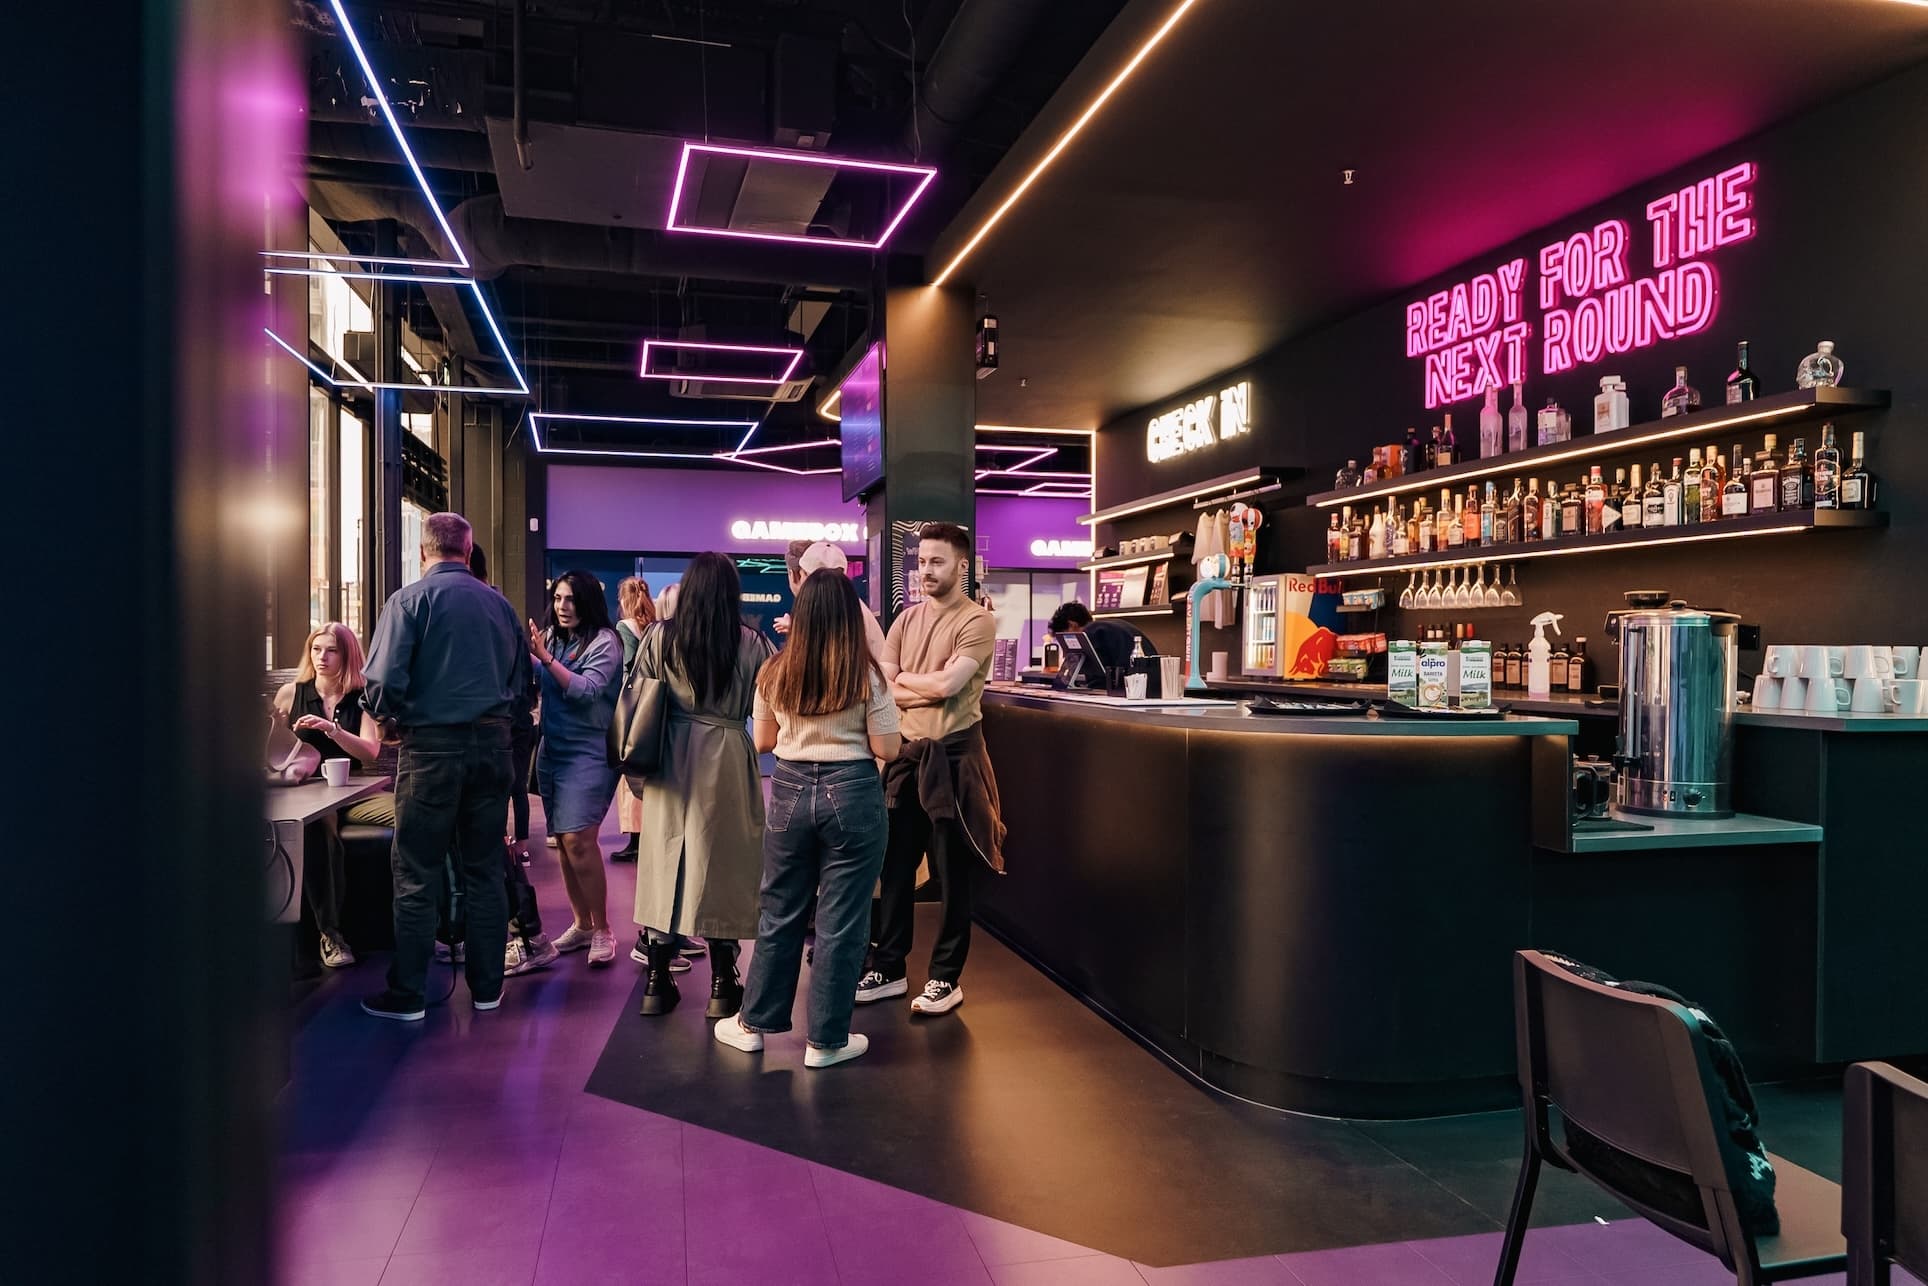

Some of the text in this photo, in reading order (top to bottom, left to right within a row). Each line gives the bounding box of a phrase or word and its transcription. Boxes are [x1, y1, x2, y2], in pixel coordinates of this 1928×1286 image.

[1406, 162, 1757, 357] READY FOR THE
[1424, 261, 1717, 409] NEXT ROUND
[1146, 395, 1218, 463] CHECK
[1288, 577, 1317, 592] Red
[1421, 658, 1446, 669] alpro
[1391, 668, 1413, 677] Milk
[1462, 670, 1486, 679] Milk
